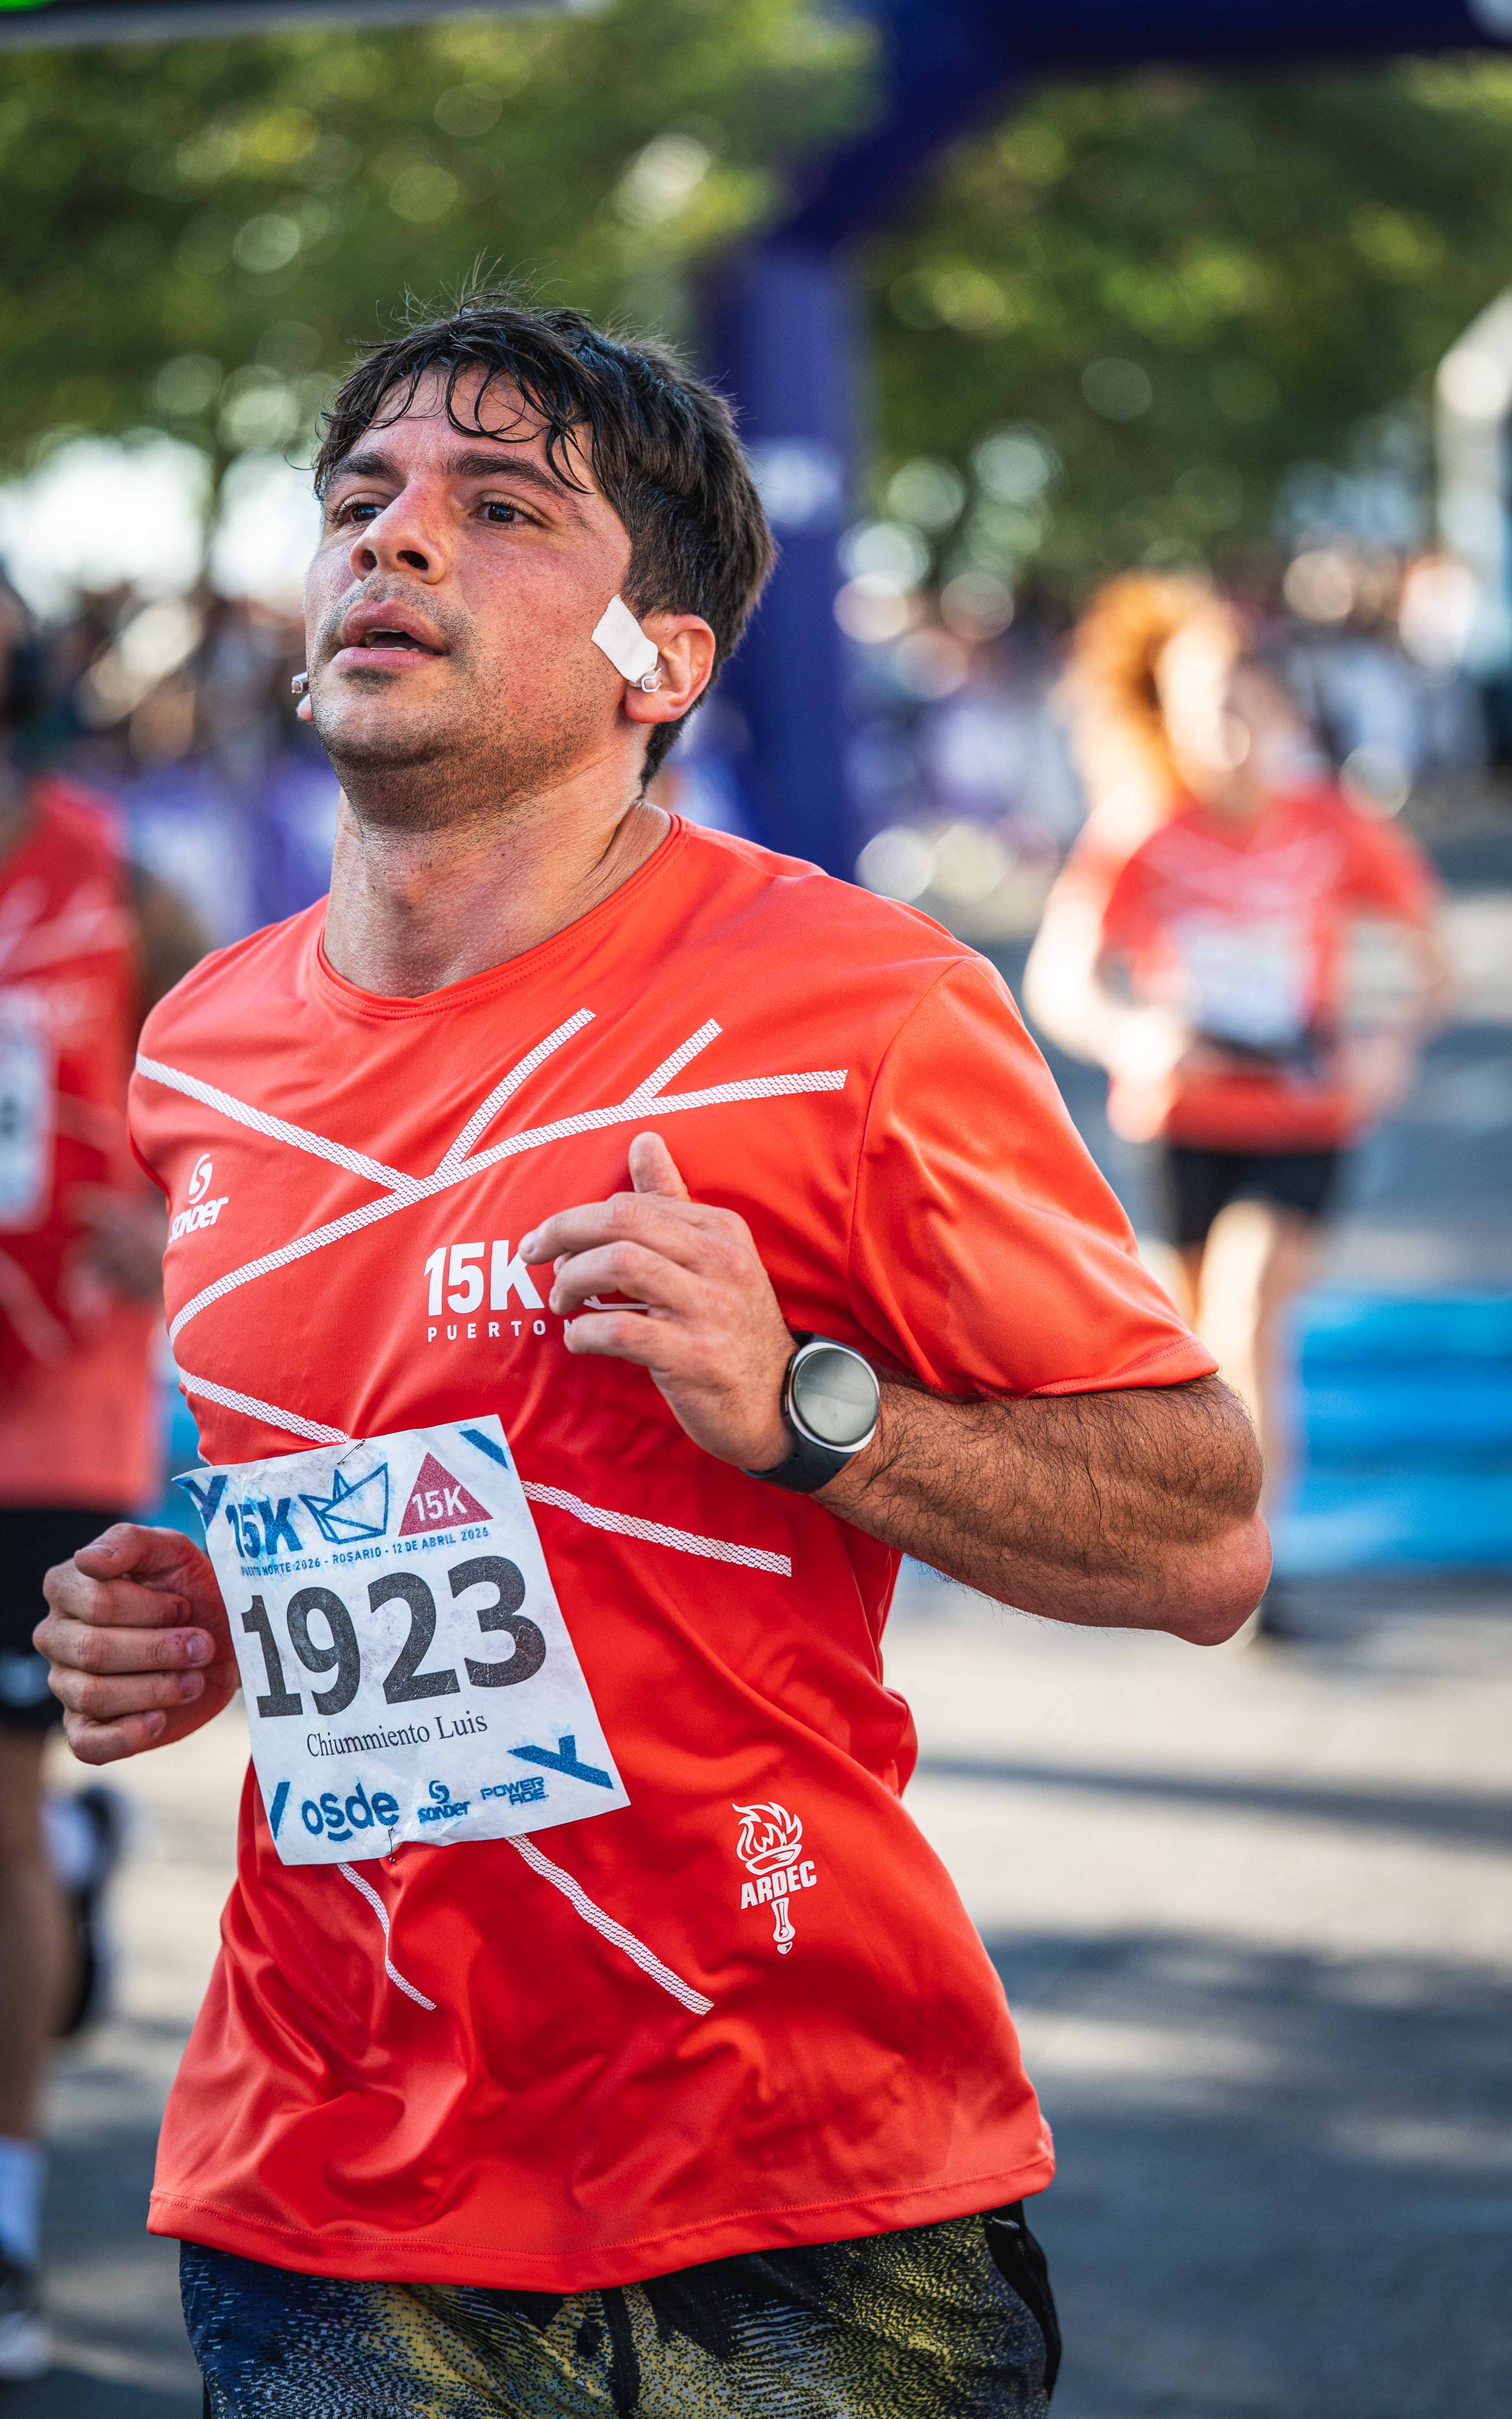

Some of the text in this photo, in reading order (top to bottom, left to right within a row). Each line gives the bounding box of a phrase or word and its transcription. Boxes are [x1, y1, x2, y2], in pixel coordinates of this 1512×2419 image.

[424, 1240, 545, 1316] 15K
[428, 1320, 546, 1342] PUERTO
[225, 1497, 303, 1558] 15K
[411, 1485, 468, 1522] 15K
[241, 1566, 262, 1577] PUERTO
[262, 1562, 291, 1576] NORTE
[295, 1557, 320, 1570] 2026
[333, 1546, 382, 1564] ROSARIO
[392, 1544, 402, 1554] 12
[405, 1540, 418, 1552] DE
[422, 1533, 457, 1548] ABRIL
[461, 1527, 489, 1542] 2026
[241, 1555, 546, 1718] 1923
[307, 1710, 488, 1757] Chiummiento Luis
[302, 1782, 400, 1835] osde
[480, 1776, 544, 1800] POWER
[509, 1788, 546, 1806] ADE
[741, 1860, 817, 1909] ARDEC
